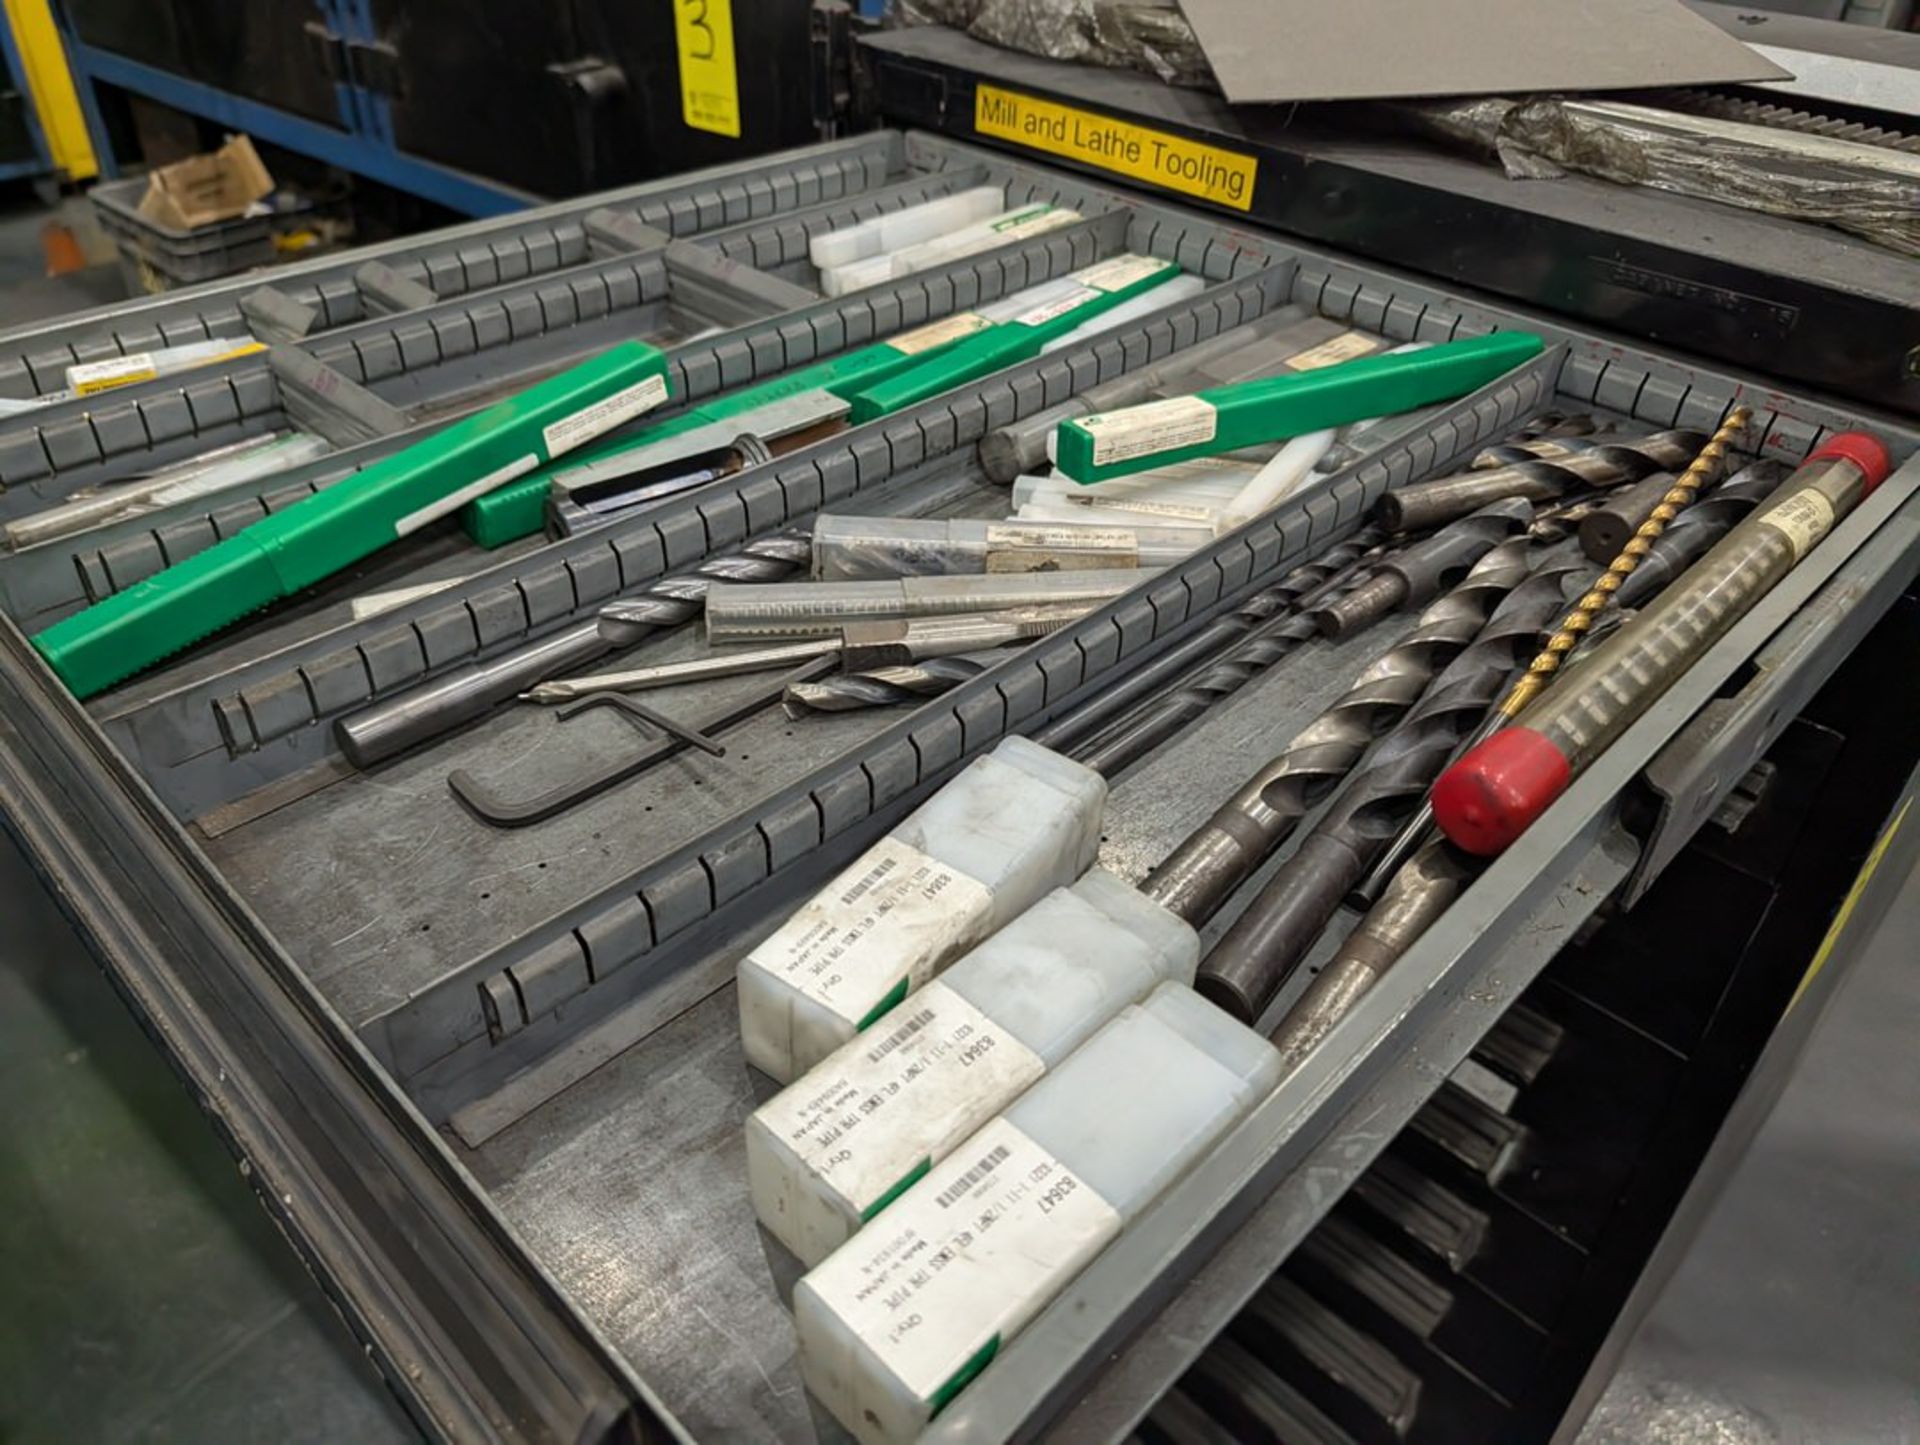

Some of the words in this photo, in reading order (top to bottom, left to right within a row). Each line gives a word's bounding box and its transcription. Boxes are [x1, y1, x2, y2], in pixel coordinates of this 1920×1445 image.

[981, 96, 1017, 126] Mill
[1023, 116, 1066, 142] and
[1073, 119, 1141, 163] Lathe
[1151, 140, 1245, 200] Tooling
[957, 1034, 996, 1068] 83647
[791, 1113, 825, 1141] JAPAN
[815, 1126, 842, 1149] PIPE
[1036, 1175, 1076, 1214] 83647
[882, 1284, 912, 1310] PIPE
